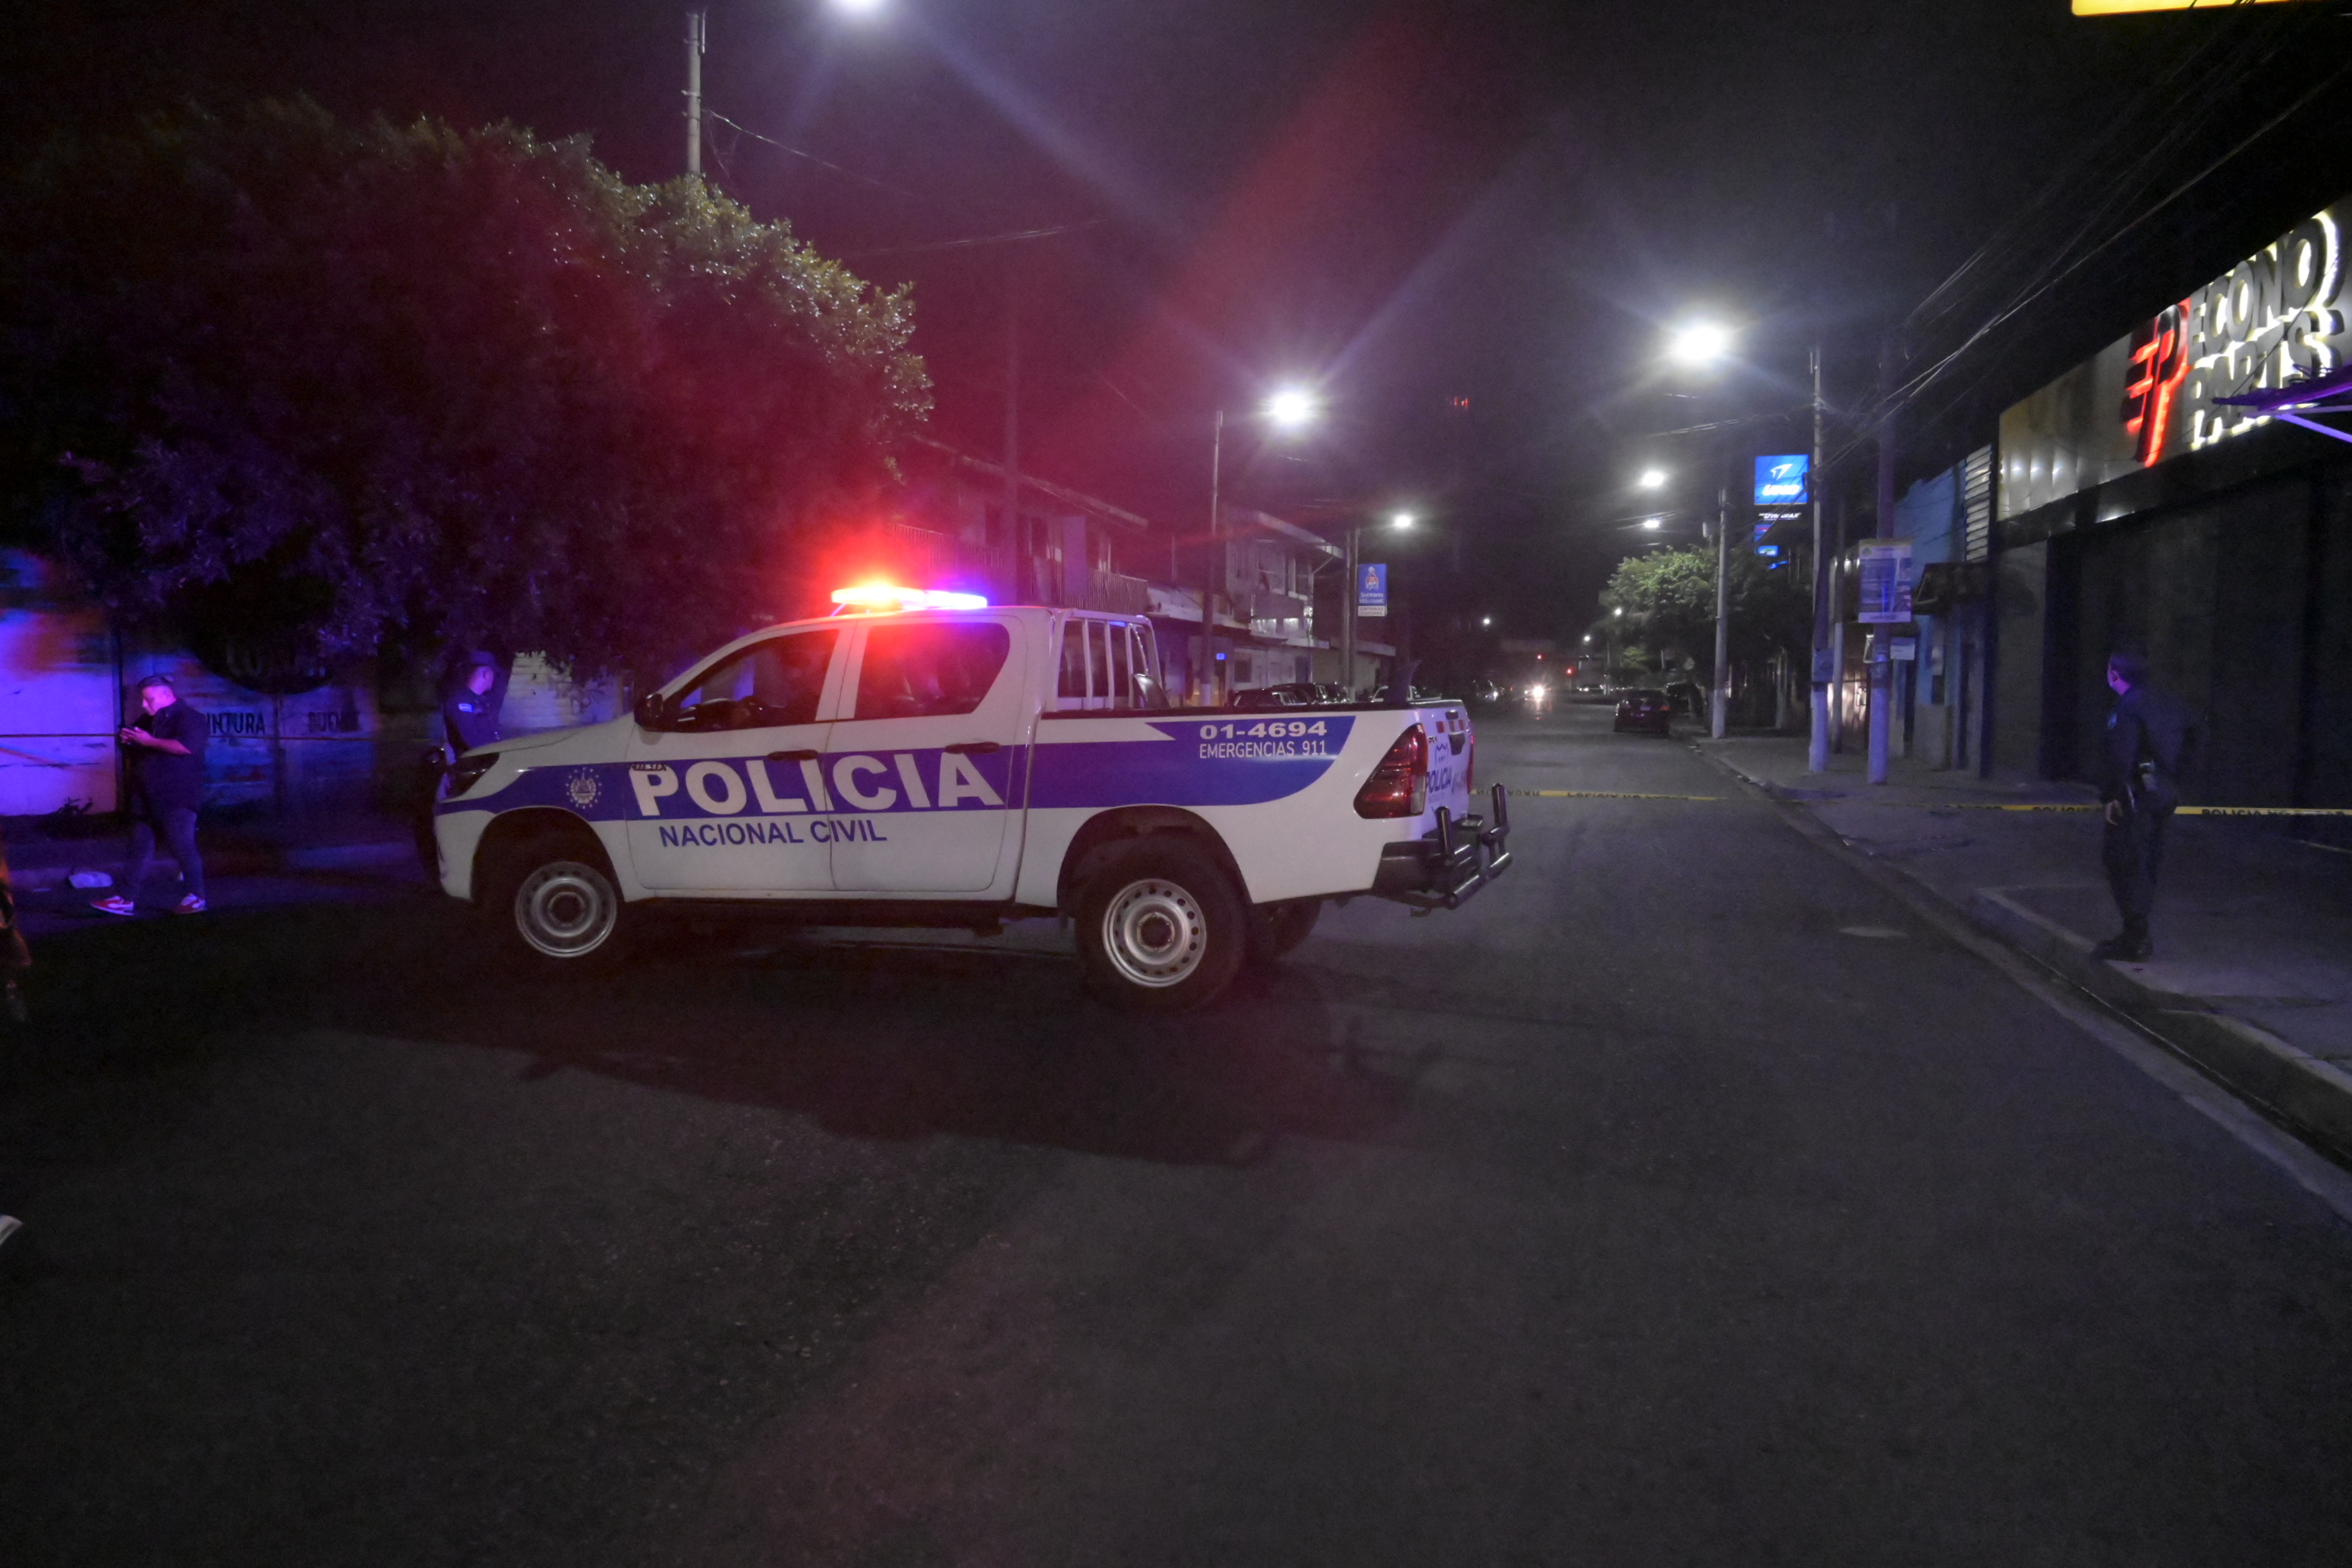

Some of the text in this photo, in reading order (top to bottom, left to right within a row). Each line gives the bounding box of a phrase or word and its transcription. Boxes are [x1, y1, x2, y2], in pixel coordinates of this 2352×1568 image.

[2189, 212, 2336, 366] ECONO
[1762, 484, 1801, 496] UNO
[1199, 721, 1327, 740] 01-4694
[1199, 740, 1327, 759] EMERGENCIAS 911
[628, 752, 1005, 817] POLICIA
[660, 819, 887, 848] NACIONAL CIVIL
